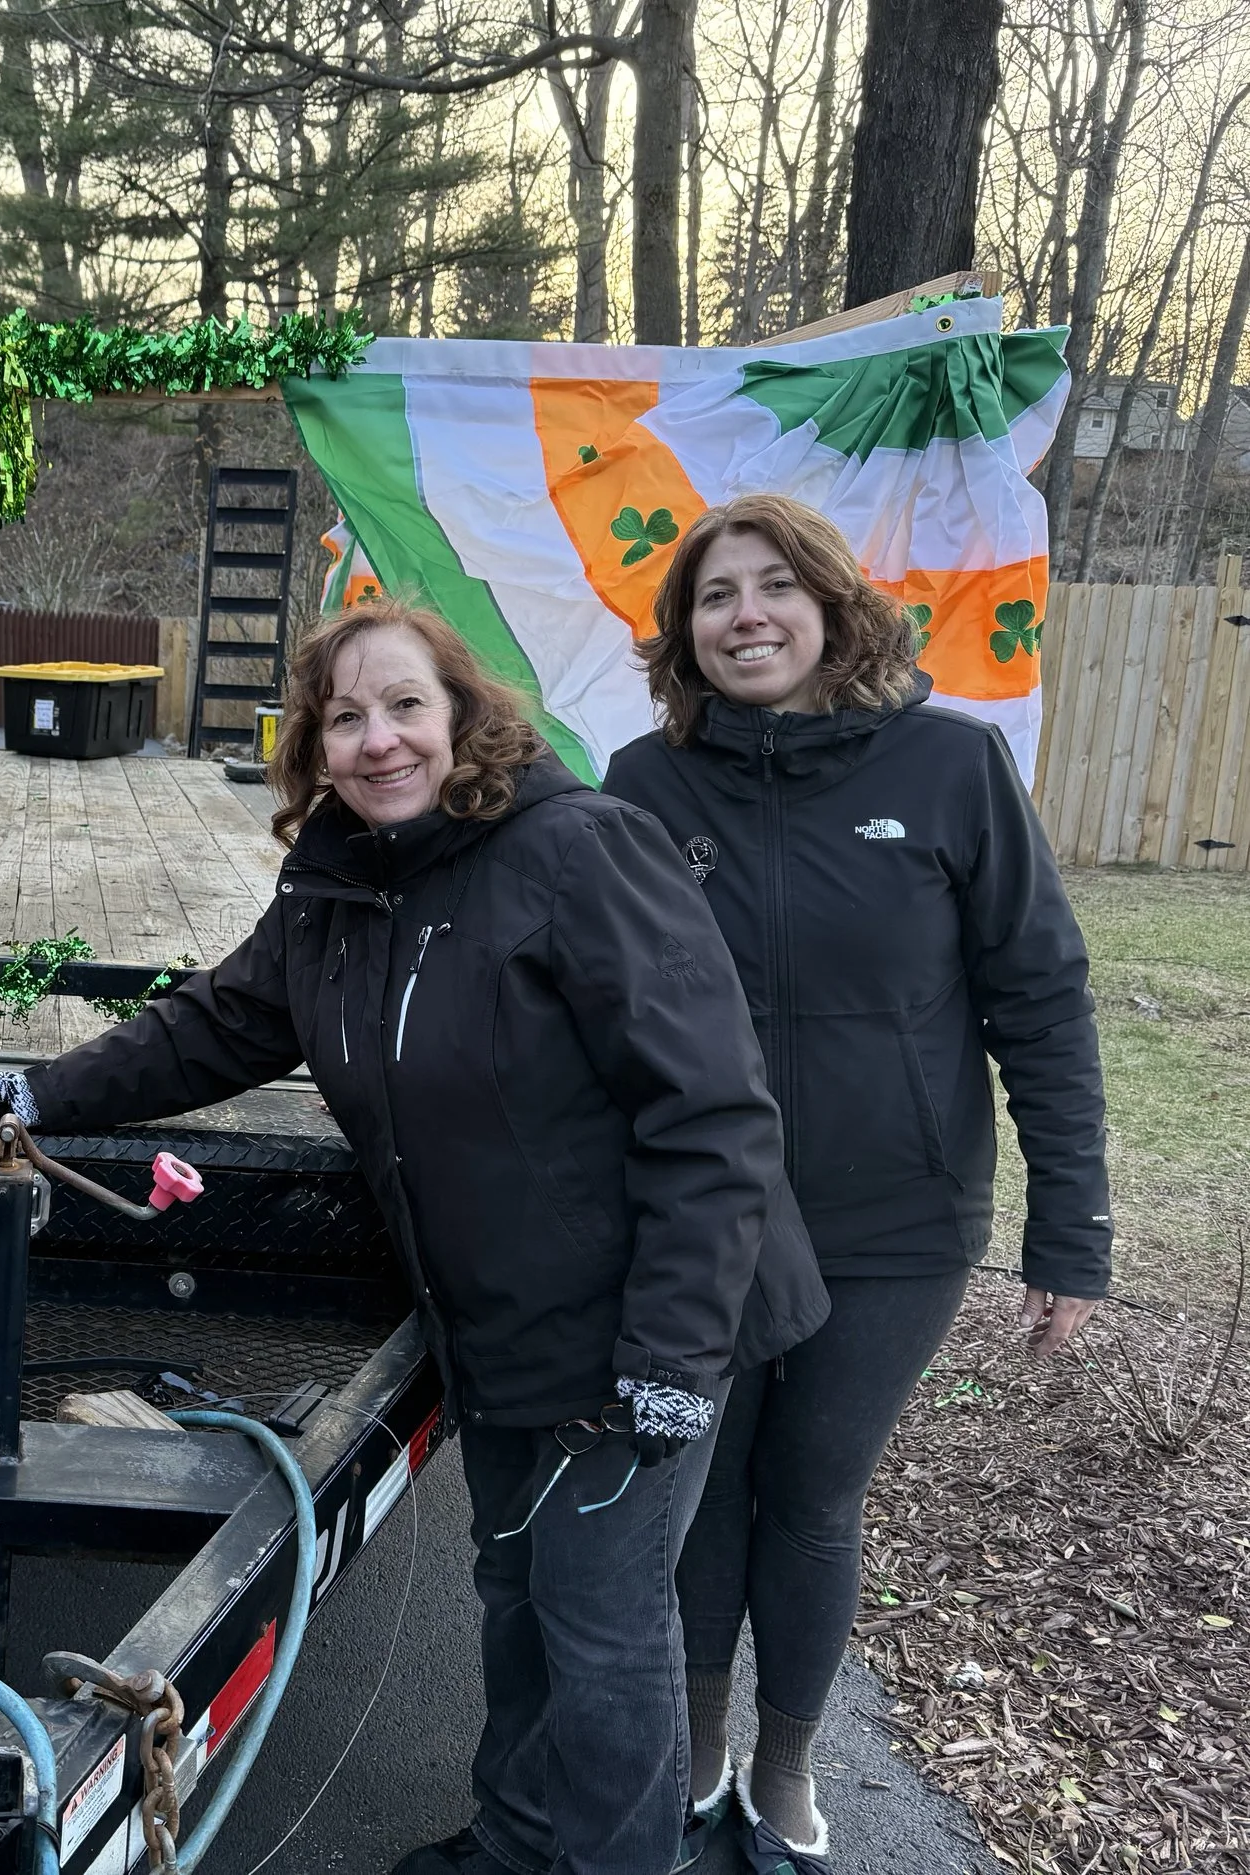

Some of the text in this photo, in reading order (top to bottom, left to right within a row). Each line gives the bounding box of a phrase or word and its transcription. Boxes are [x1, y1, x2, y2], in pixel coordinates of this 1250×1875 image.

[869, 818, 888, 826] THE
[854, 825, 888, 833] NORTH
[864, 832, 888, 840] FACE
[80, 1747, 119, 1797] WARNING
